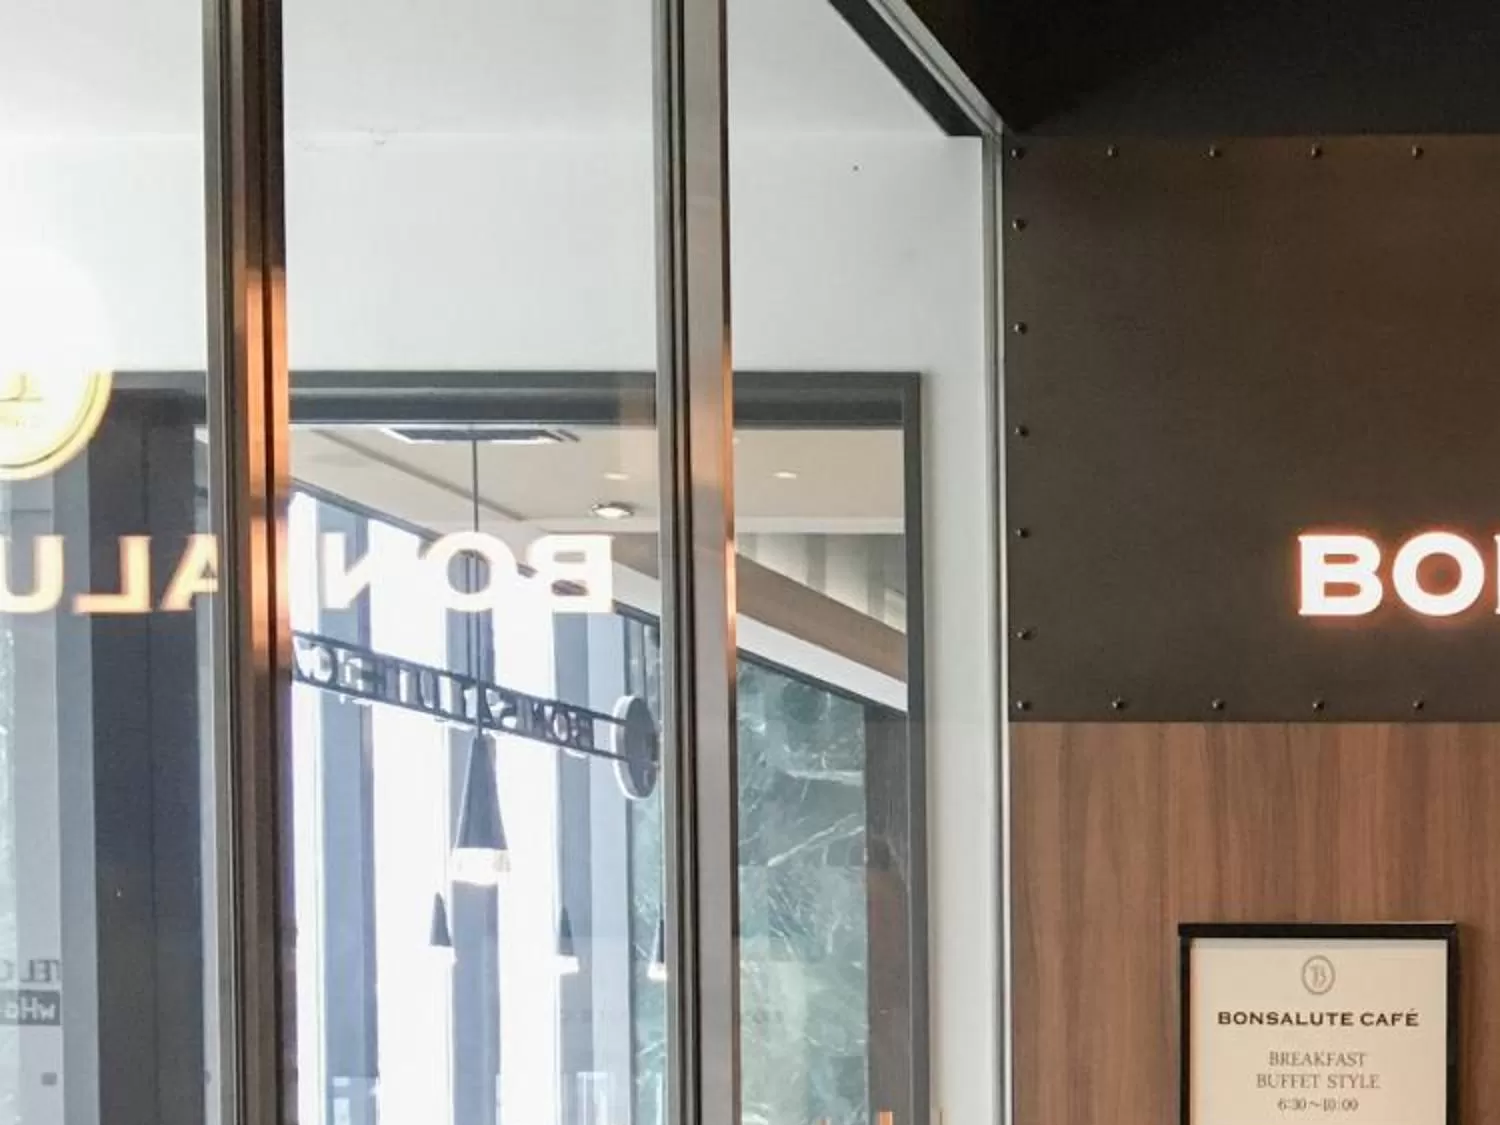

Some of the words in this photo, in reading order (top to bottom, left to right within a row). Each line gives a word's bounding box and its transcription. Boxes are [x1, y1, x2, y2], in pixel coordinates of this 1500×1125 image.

[1217, 1011, 1355, 1027] BONSALUTE
[1359, 1007, 1420, 1028] CAFÉ
[1268, 1050, 1368, 1067] BREAKFAST
[1256, 1073, 1320, 1089] BUFFET
[1326, 1073, 1381, 1089] STYLE
